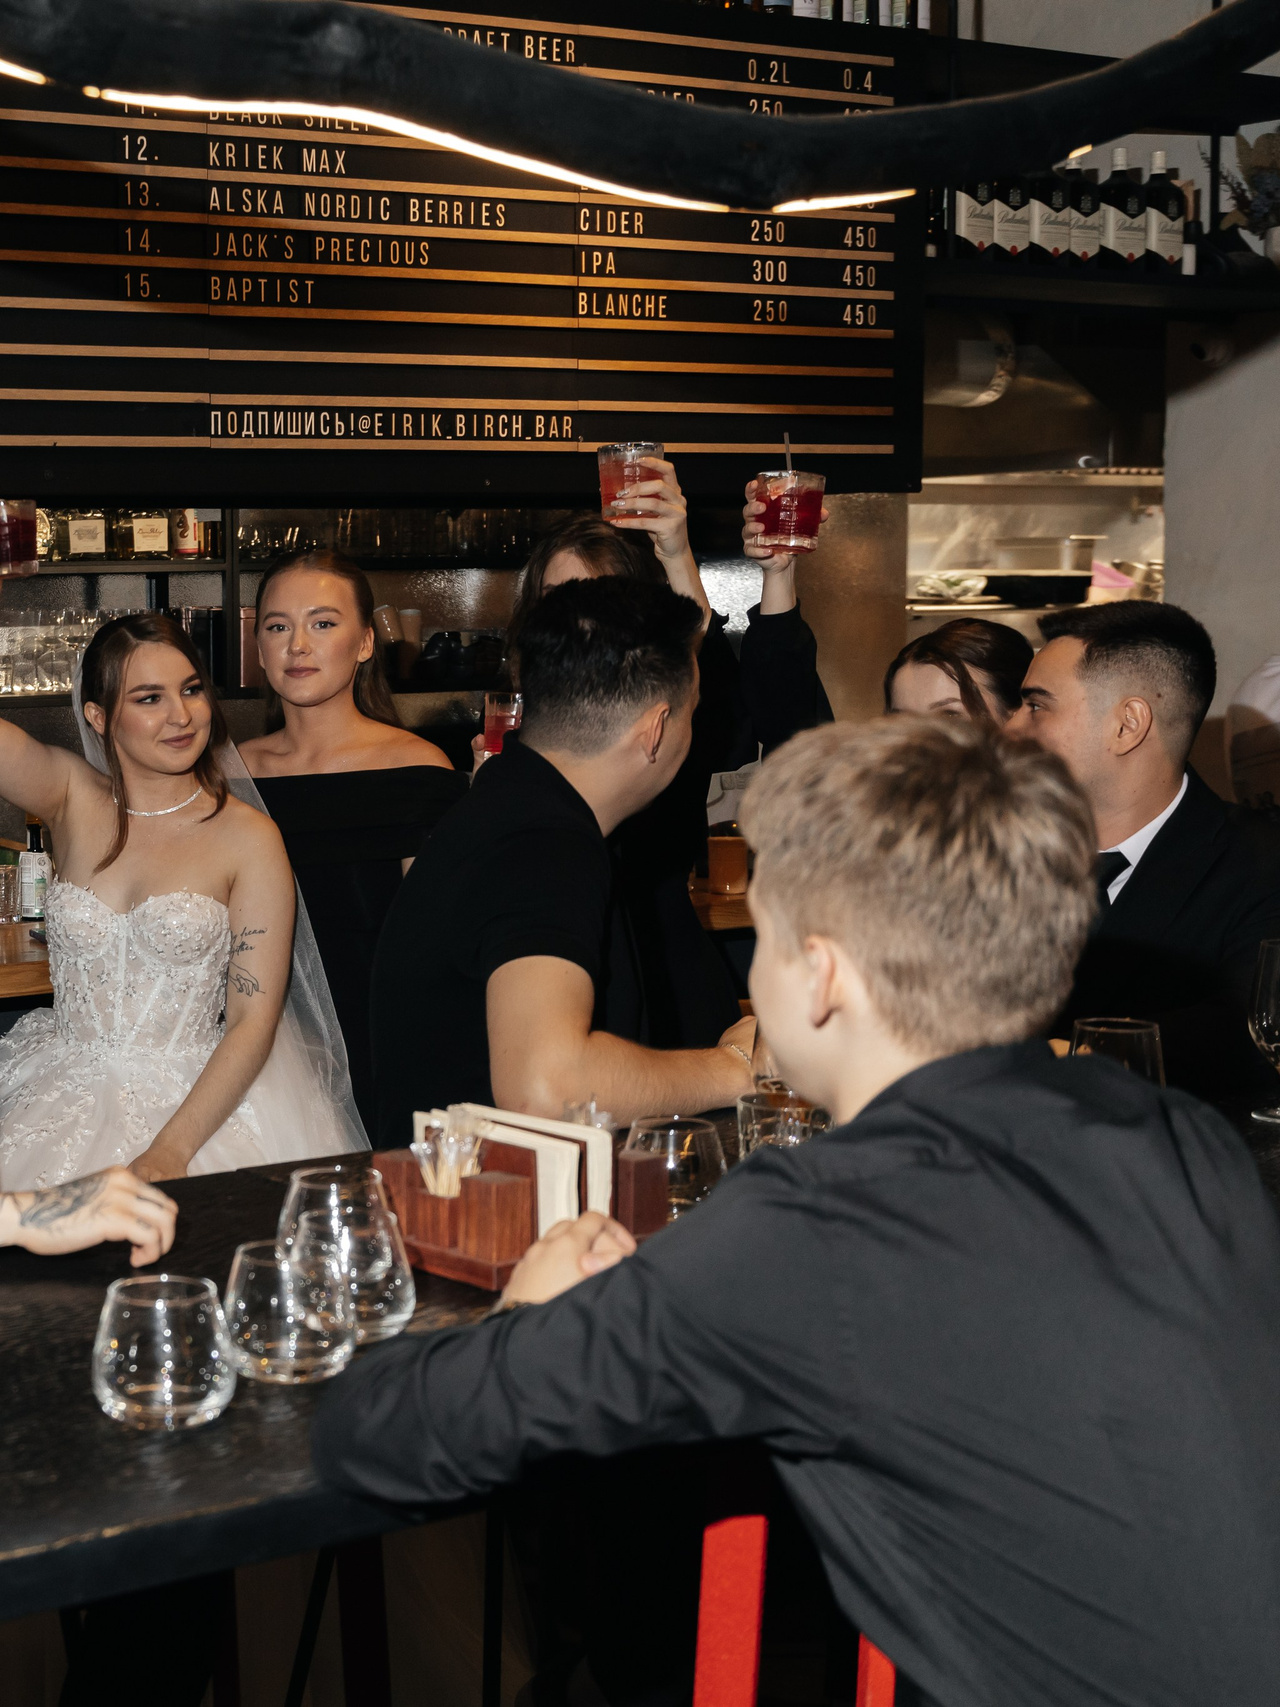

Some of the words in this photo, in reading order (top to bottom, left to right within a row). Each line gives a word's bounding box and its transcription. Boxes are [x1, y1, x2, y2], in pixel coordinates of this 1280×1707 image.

[525, 36, 574, 62] BEER
[749, 59, 789, 83] 0.2L
[844, 69, 872, 91] 0.4
[123, 135, 158, 160] 12.
[210, 142, 283, 170] KRIEK
[303, 149, 345, 174] MAX
[125, 182, 159, 206] 13.
[210, 187, 283, 214] ALSKA
[306, 193, 389, 220] NORDIC
[410, 199, 505, 226] BERRIES
[580, 208, 643, 234] CIDER
[751, 220, 784, 242] 250
[126, 228, 160, 252] 14.
[844, 227, 875, 248] 450
[316, 237, 428, 265] PRECIOUS
[582, 251, 615, 274] IPA
[753, 260, 786, 282] 300
[843, 265, 875, 287] 450
[125, 273, 160, 297] 15.
[211, 277, 314, 304] BAPTIST
[579, 292, 667, 318] BLANCHE
[754, 300, 787, 321] 250
[843, 305, 875, 325] 450
